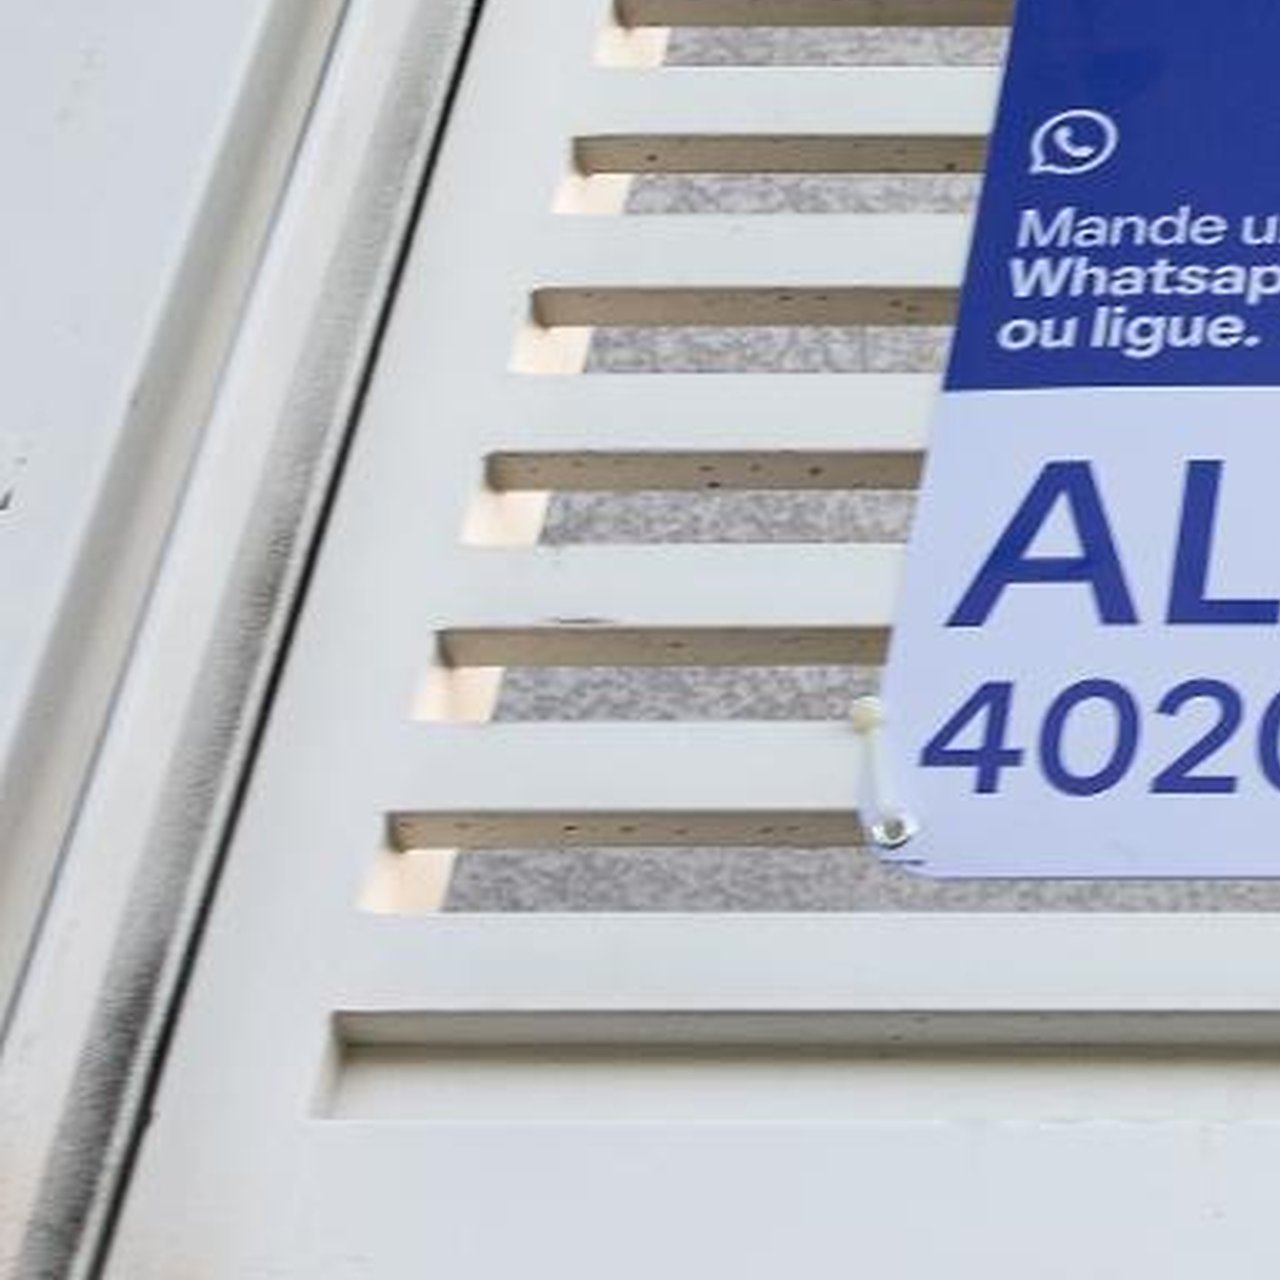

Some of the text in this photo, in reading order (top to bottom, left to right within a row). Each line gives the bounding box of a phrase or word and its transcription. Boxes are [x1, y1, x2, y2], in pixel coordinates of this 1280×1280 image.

[1016, 205, 1228, 248] Mande
[997, 305, 1261, 359] ou ligue.
